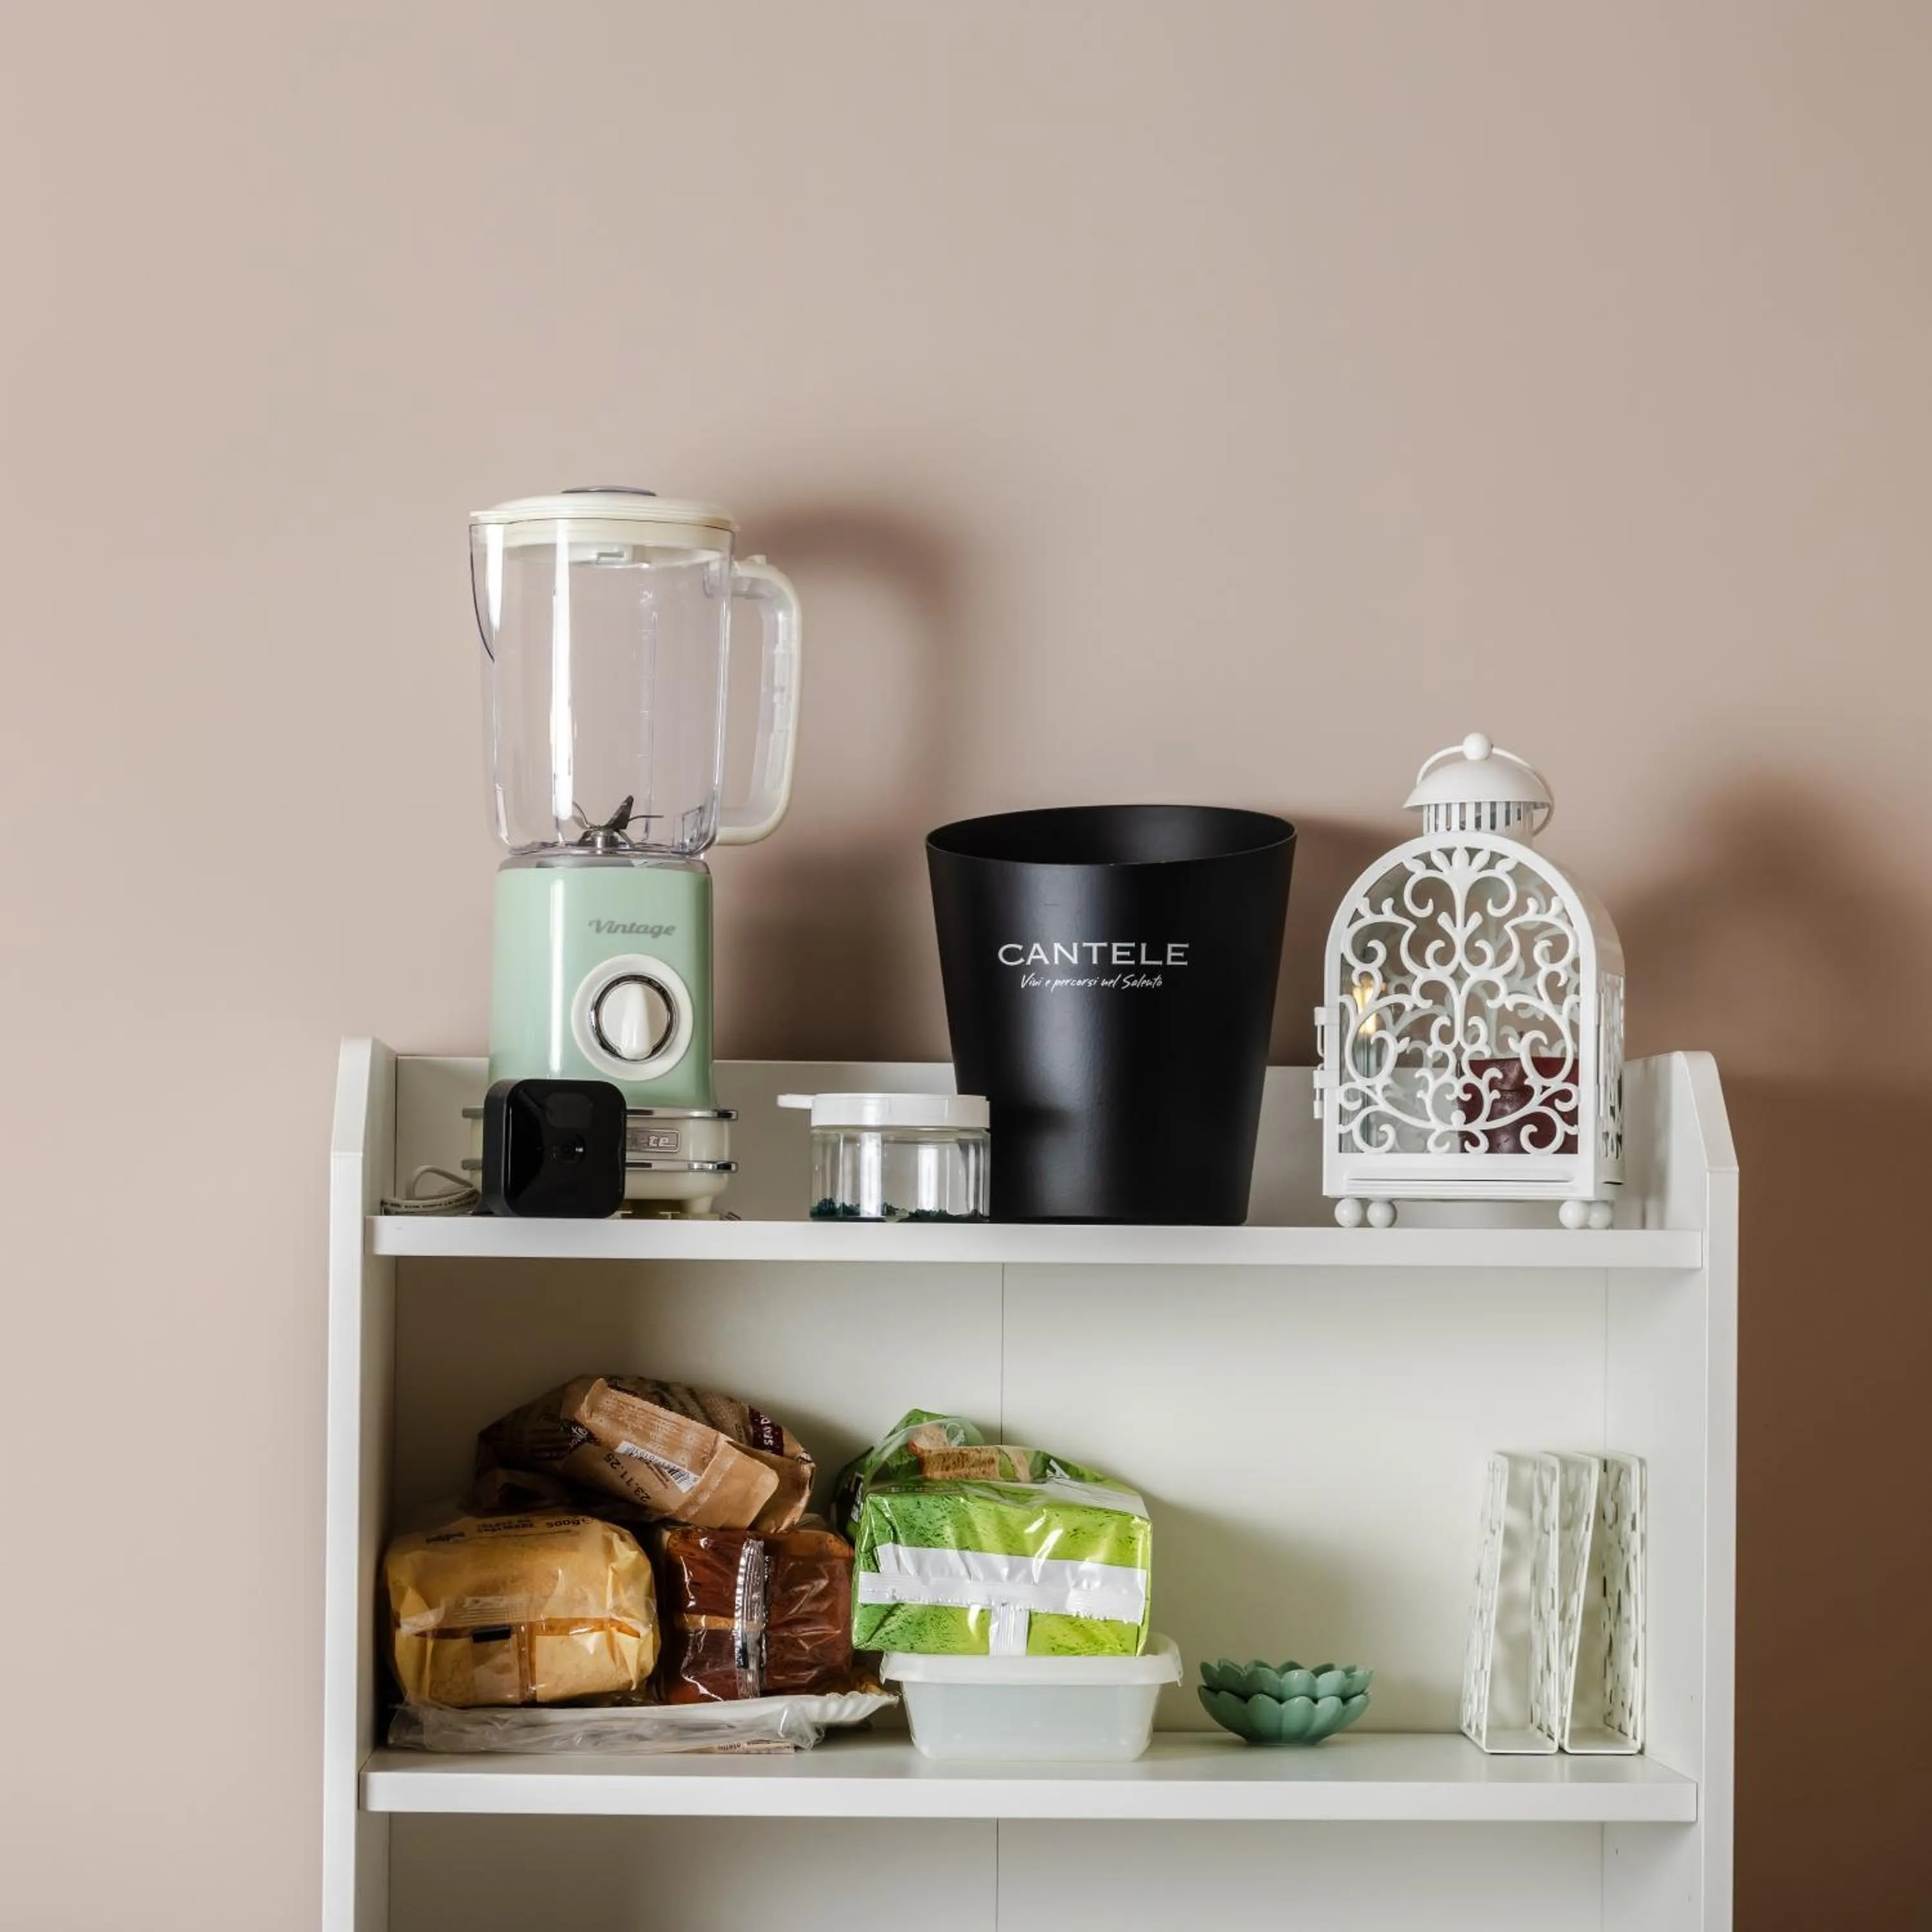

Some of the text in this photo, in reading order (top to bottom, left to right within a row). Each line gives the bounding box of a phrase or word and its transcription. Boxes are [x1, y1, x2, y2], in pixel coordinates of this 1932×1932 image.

[587, 918, 677, 939] Vintage
[998, 942, 1189, 966] CANTELE
[1021, 972, 1043, 989] Vini
[1045, 978, 1051, 987] e
[1051, 976, 1099, 993] percorsi
[1101, 974, 1122, 988] nel
[603, 1452, 652, 1502] 23.11.25
